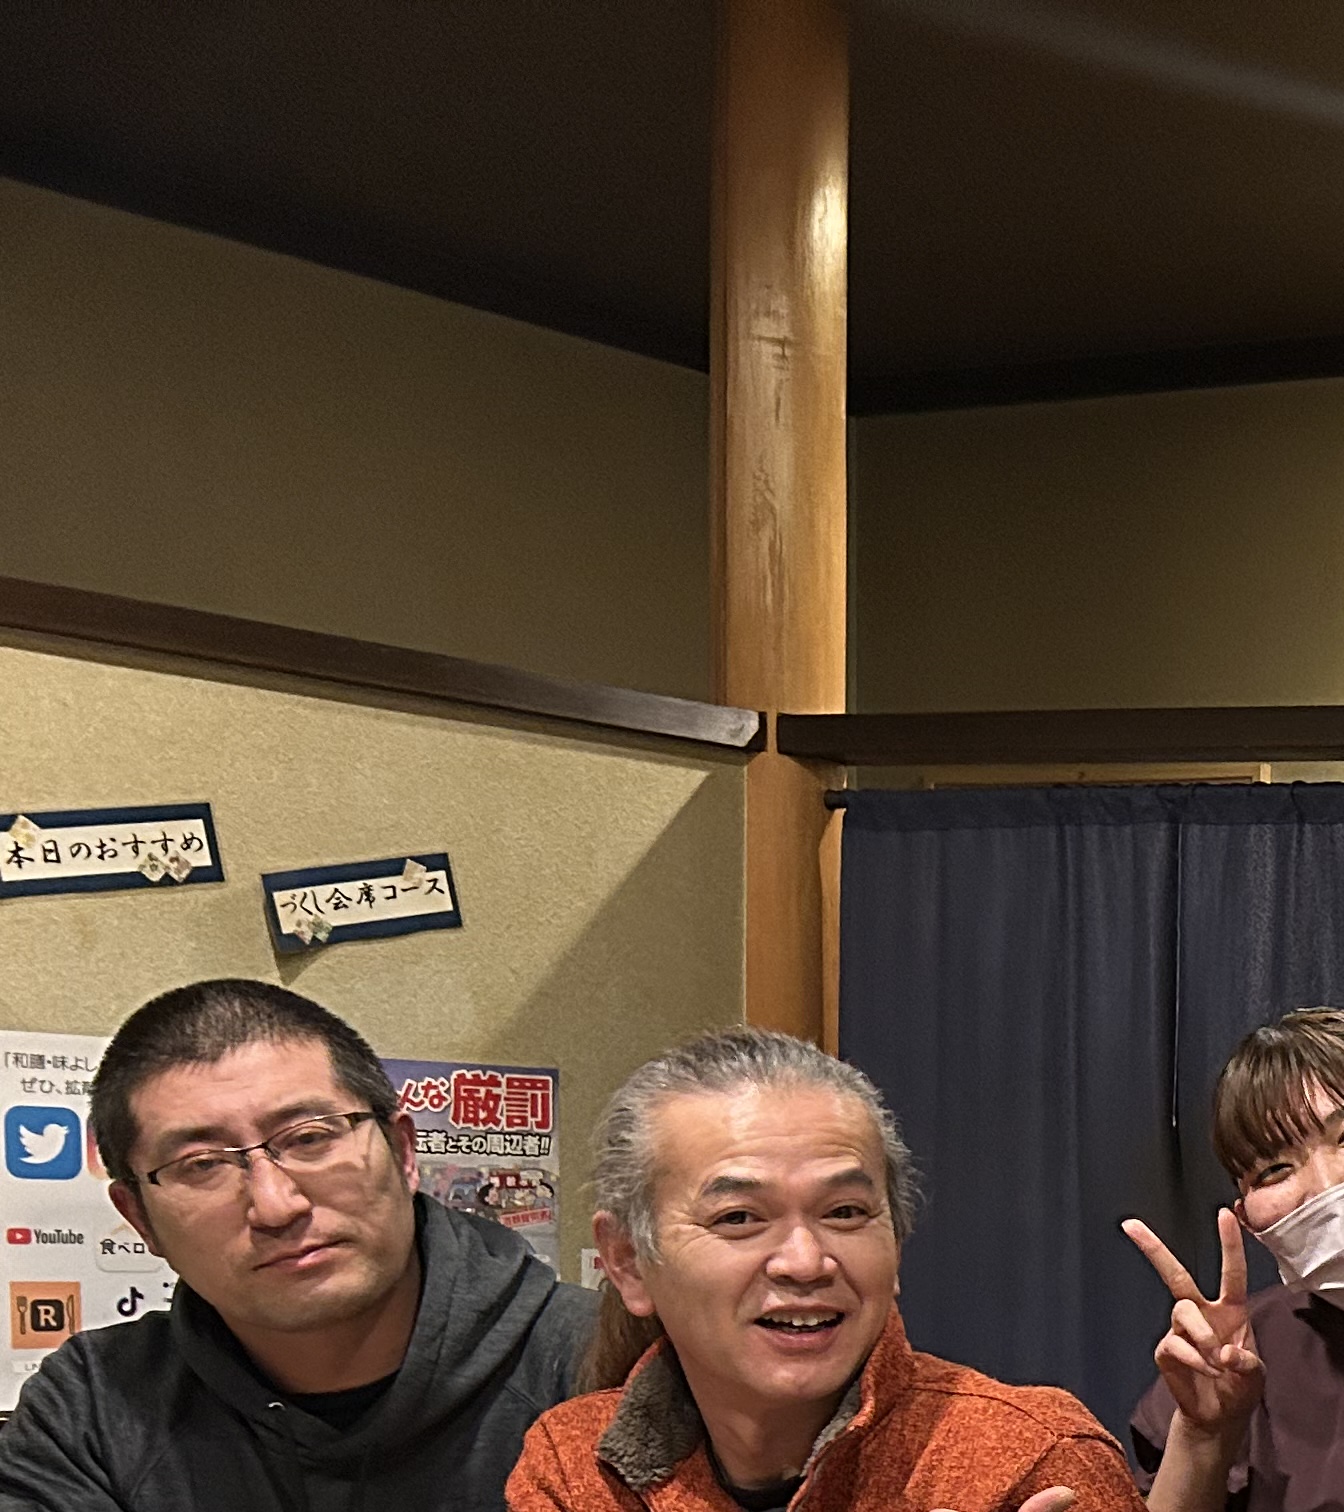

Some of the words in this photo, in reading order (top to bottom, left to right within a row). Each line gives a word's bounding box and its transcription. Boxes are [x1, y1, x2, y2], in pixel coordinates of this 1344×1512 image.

[6, 831, 204, 869] 本日のおすすめ
[280, 878, 444, 915] づくし会席コース
[34, 1229, 84, 1244] YouTube
[38, 1305, 57, 1328] R
